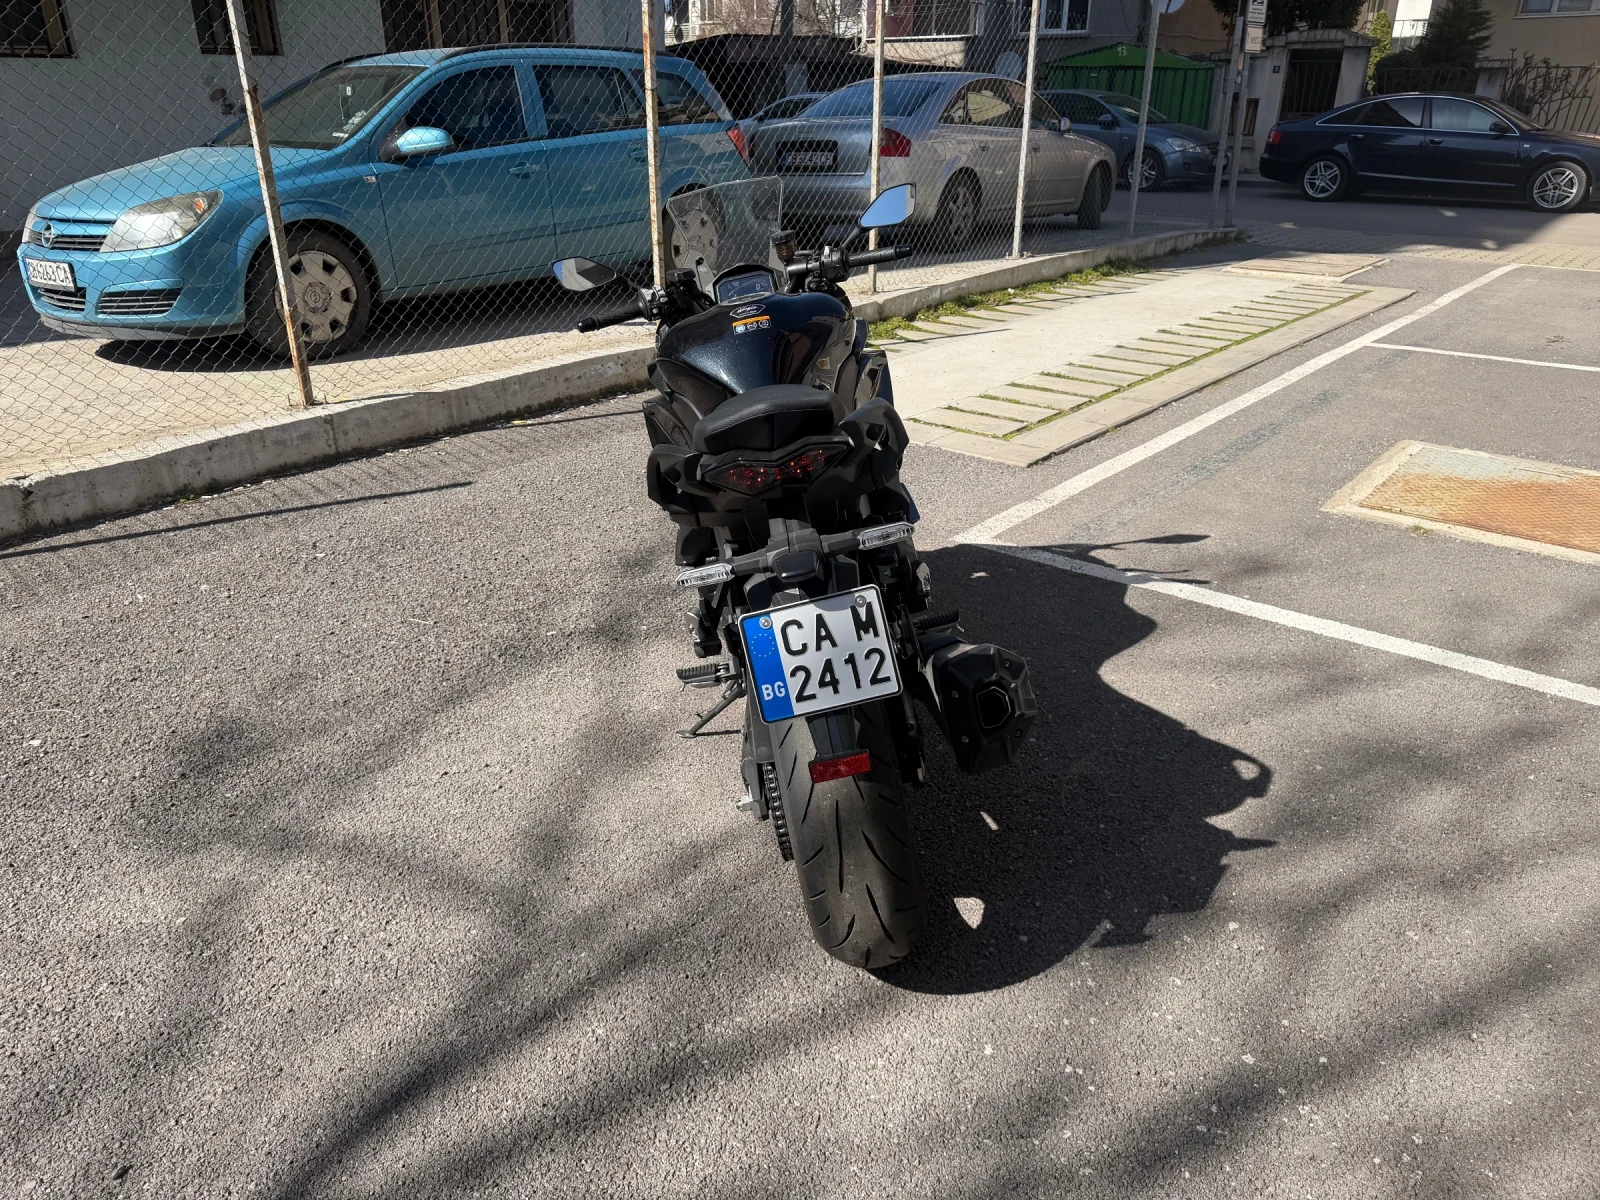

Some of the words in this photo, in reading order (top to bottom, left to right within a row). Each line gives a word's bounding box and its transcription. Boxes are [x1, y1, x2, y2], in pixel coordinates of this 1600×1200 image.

[1117, 46, 1127, 56] 13
[780, 612, 839, 657] CA
[849, 600, 880, 643] M
[761, 681, 786, 701] BG
[789, 647, 892, 704] 2412
